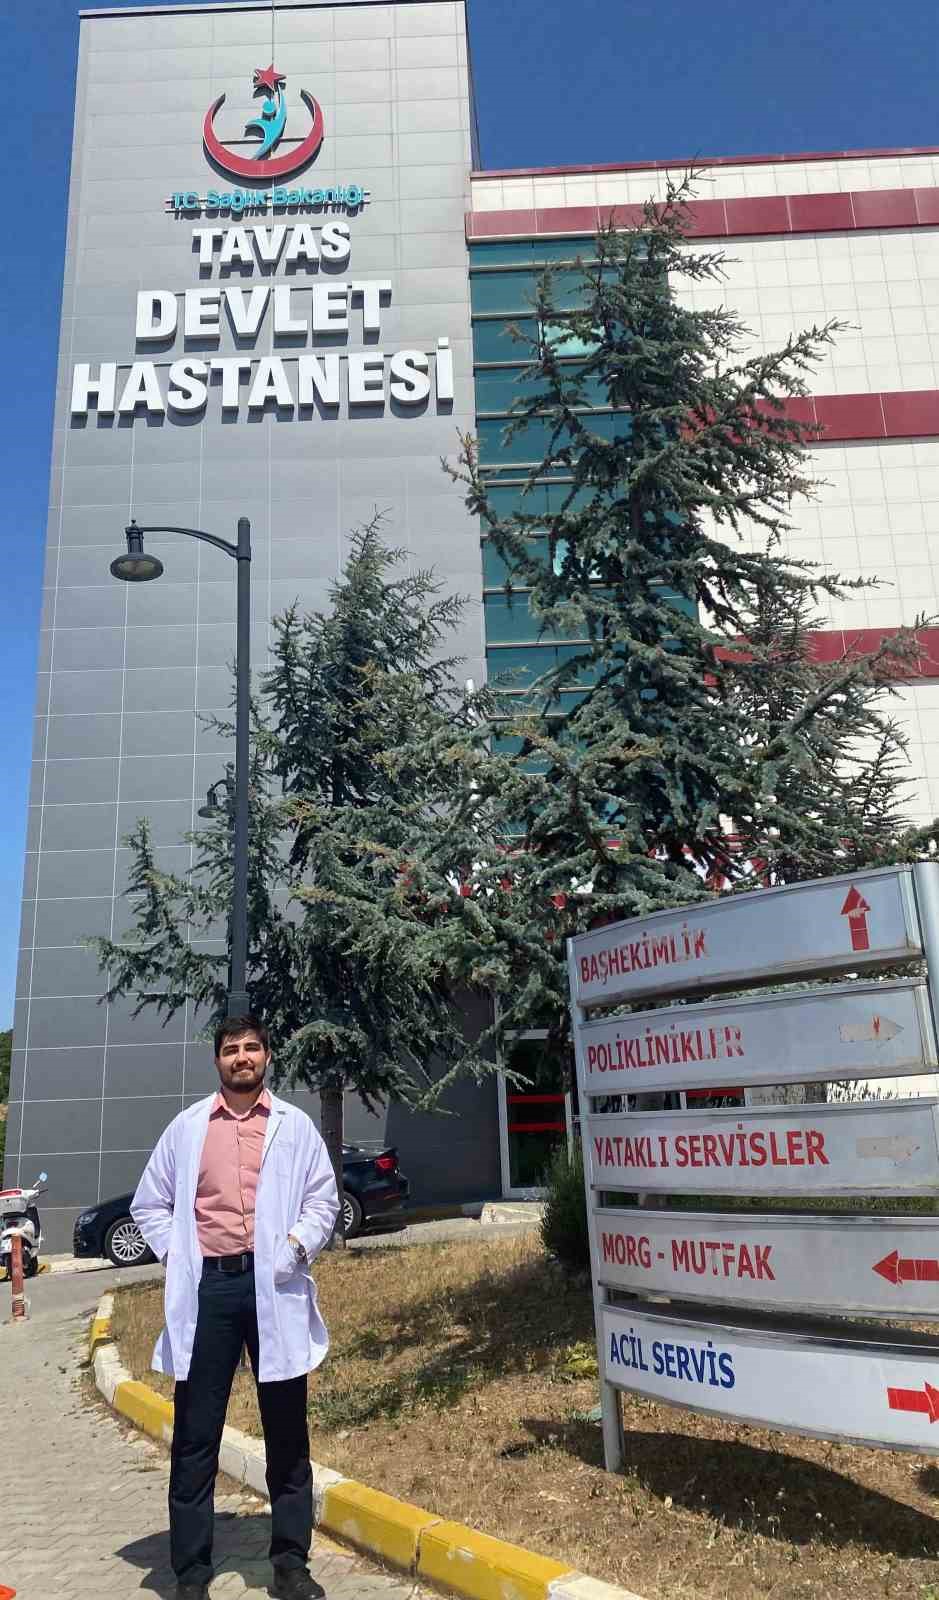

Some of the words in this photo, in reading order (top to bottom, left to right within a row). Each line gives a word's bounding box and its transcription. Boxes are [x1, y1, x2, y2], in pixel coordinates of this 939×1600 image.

[192, 221, 351, 266] TAVAS
[135, 280, 392, 343] DEVLET
[71, 337, 454, 416] HASTANESİ
[594, 1135, 669, 1168] YATAKLI
[675, 1123, 830, 1168] SERVİSLER
[602, 1231, 652, 1269] MORG
[671, 1239, 776, 1281] MUTFAK
[610, 1328, 649, 1371] ACİL
[652, 1341, 735, 1388] SERVİS
